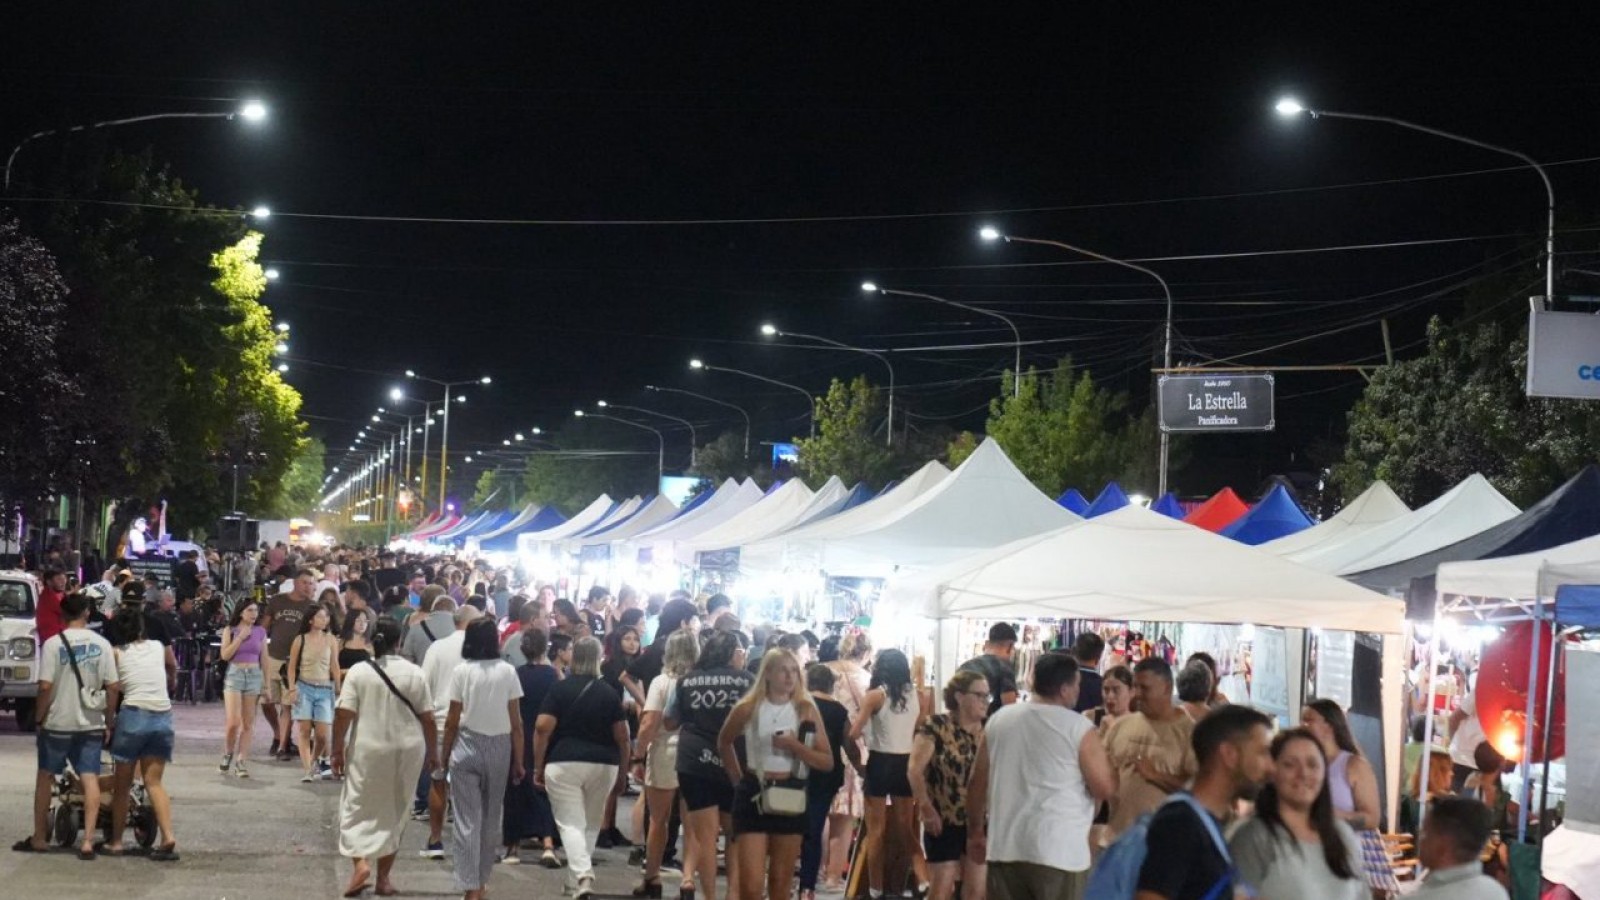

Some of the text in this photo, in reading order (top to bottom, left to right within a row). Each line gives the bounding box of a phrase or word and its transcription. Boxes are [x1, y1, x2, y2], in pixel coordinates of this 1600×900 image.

[1188, 392, 1247, 410] La Estrella
[1198, 415, 1238, 425] Panificadora
[690, 690, 741, 709] 2025
